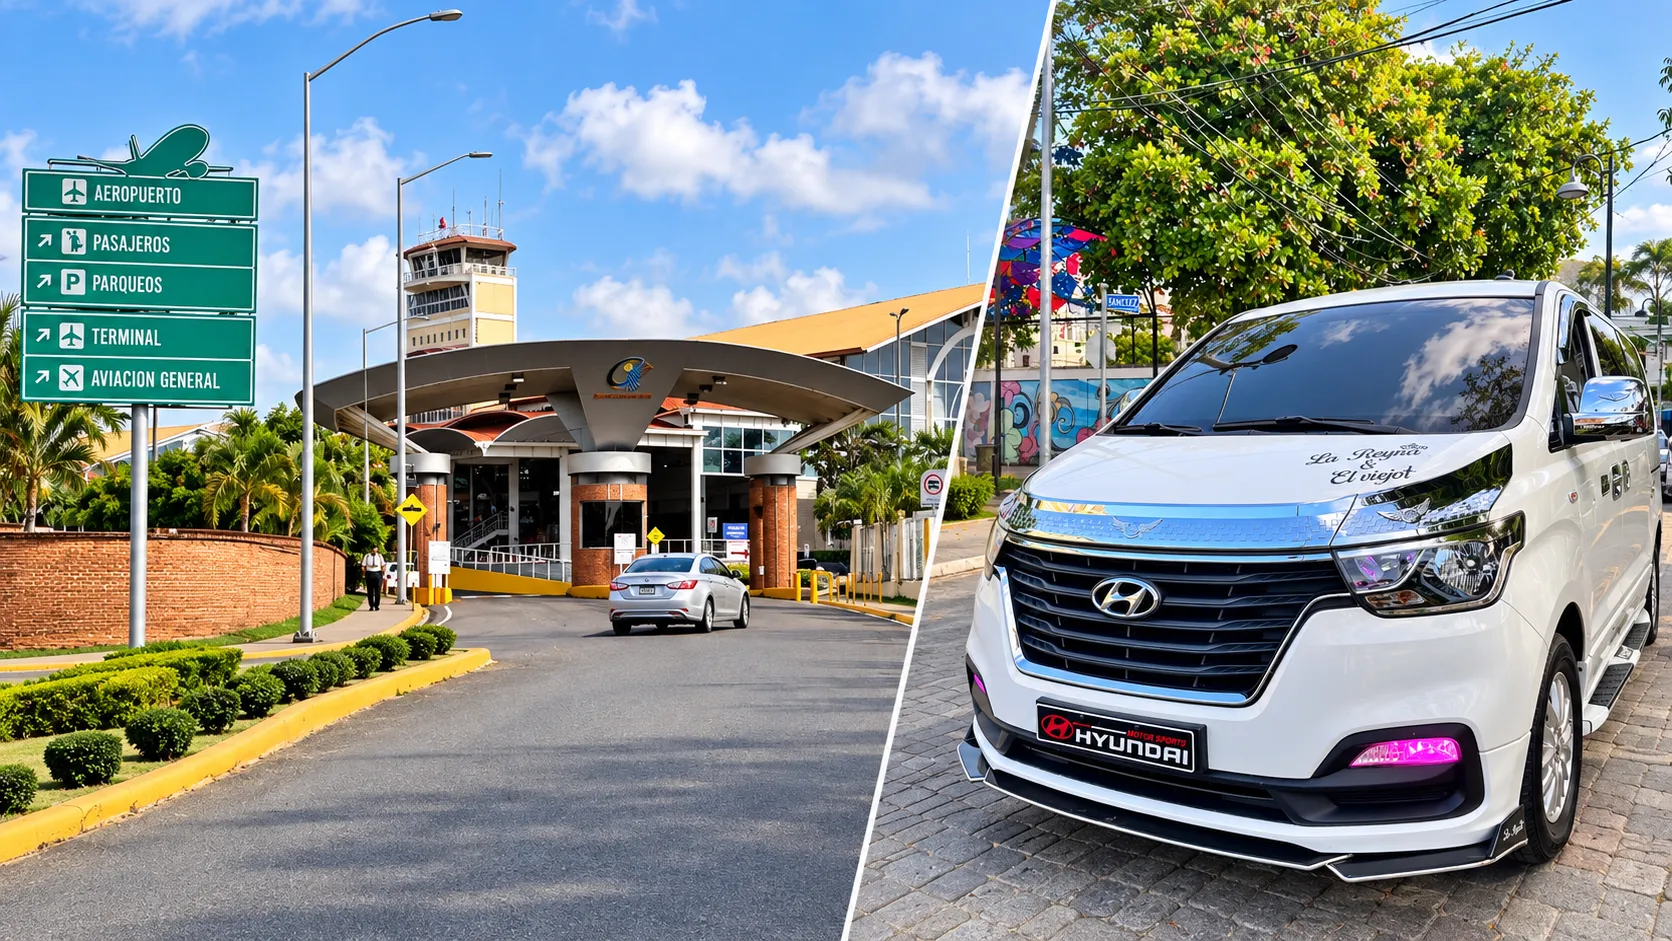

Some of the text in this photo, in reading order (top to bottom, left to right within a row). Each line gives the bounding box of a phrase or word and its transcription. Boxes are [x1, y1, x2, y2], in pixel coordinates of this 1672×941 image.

[94, 184, 182, 204] AEROPUERTO
[93, 234, 171, 253] PASAJEROS
[66, 273, 162, 294] P PARQUEOS
[91, 328, 162, 347] TERMINAL
[91, 370, 221, 389] AVIACION GENERAL
[1305, 447, 1422, 466] La Reyna
[1360, 459, 1377, 470] &
[1330, 470, 1358, 485] El
[1075, 728, 1189, 766] HYUNDAI
[1127, 729, 1187, 747] MOTOR SPORTS
